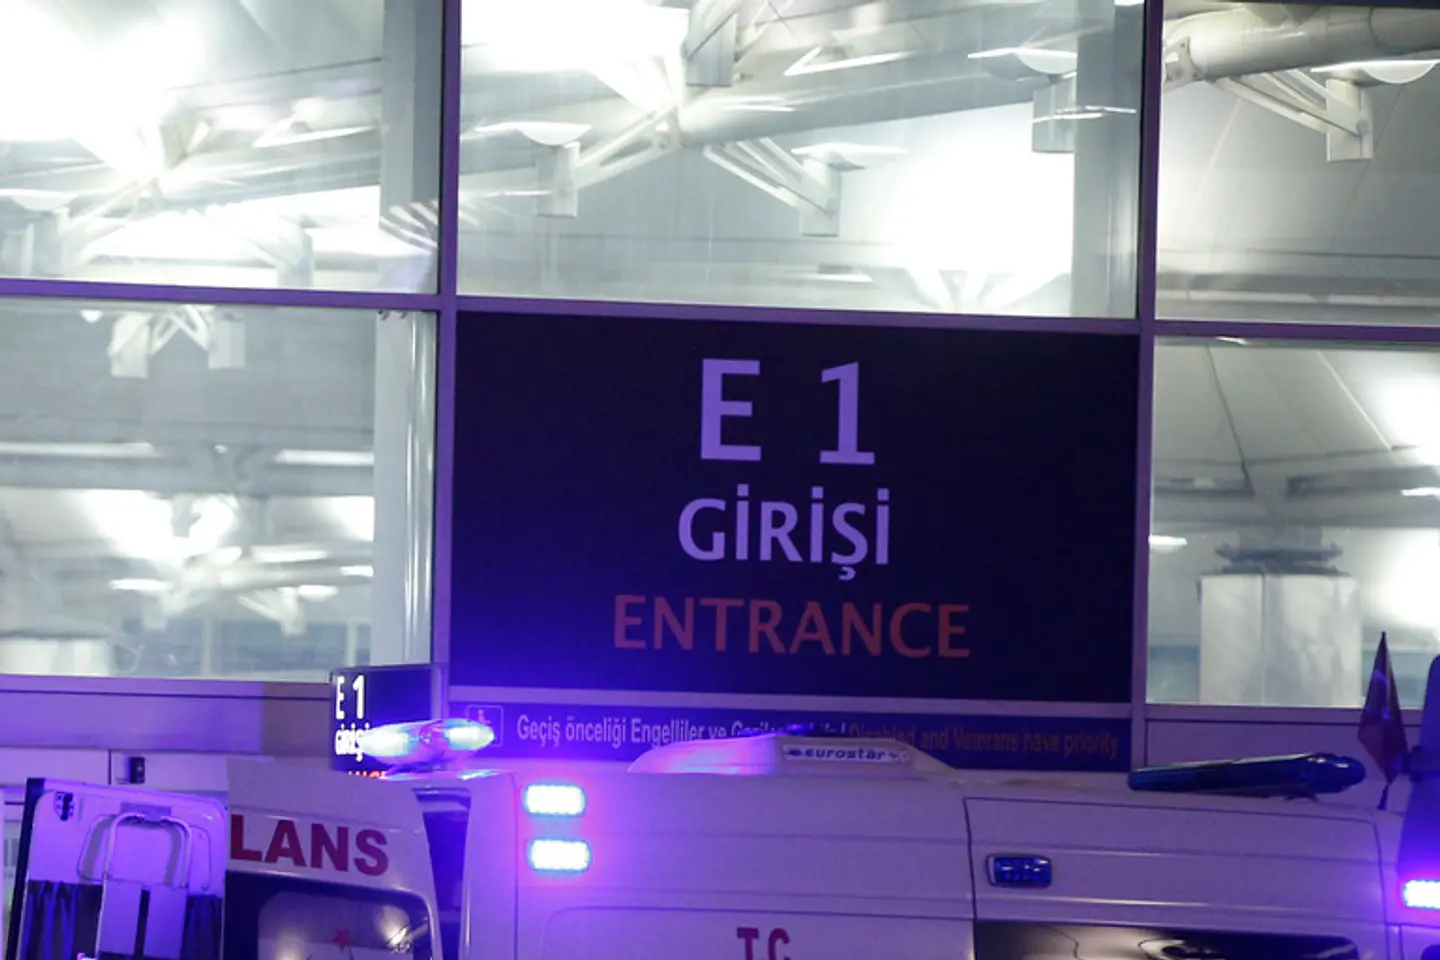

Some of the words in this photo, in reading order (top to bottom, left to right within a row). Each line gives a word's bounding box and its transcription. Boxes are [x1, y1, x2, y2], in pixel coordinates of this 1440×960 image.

[700, 358, 761, 461] E
[819, 361, 876, 465] 1
[678, 484, 890, 581] GİRİŞİ
[613, 595, 971, 658] ENTRANCE
[336, 675, 345, 719] E
[353, 675, 364, 719] 1
[517, 714, 561, 748] Geçiş
[920, 726, 948, 749] and
